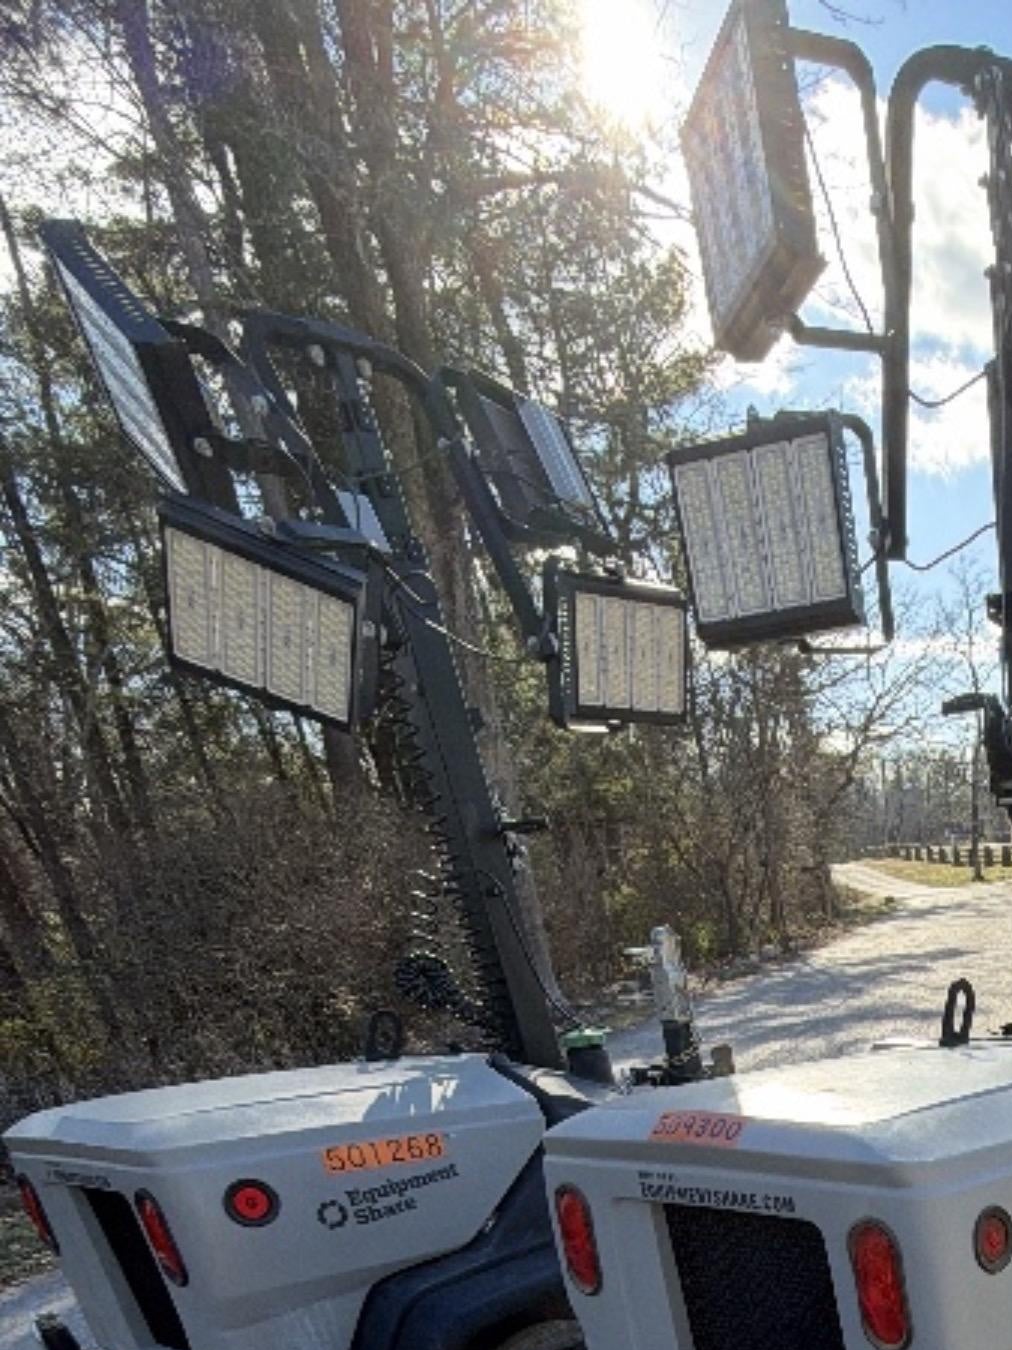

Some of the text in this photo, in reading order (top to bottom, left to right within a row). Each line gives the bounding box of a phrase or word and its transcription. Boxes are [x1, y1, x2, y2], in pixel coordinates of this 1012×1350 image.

[326, 1133, 442, 1171] 501268
[344, 1163, 459, 1207] Equipment
[353, 1197, 417, 1225] Share
